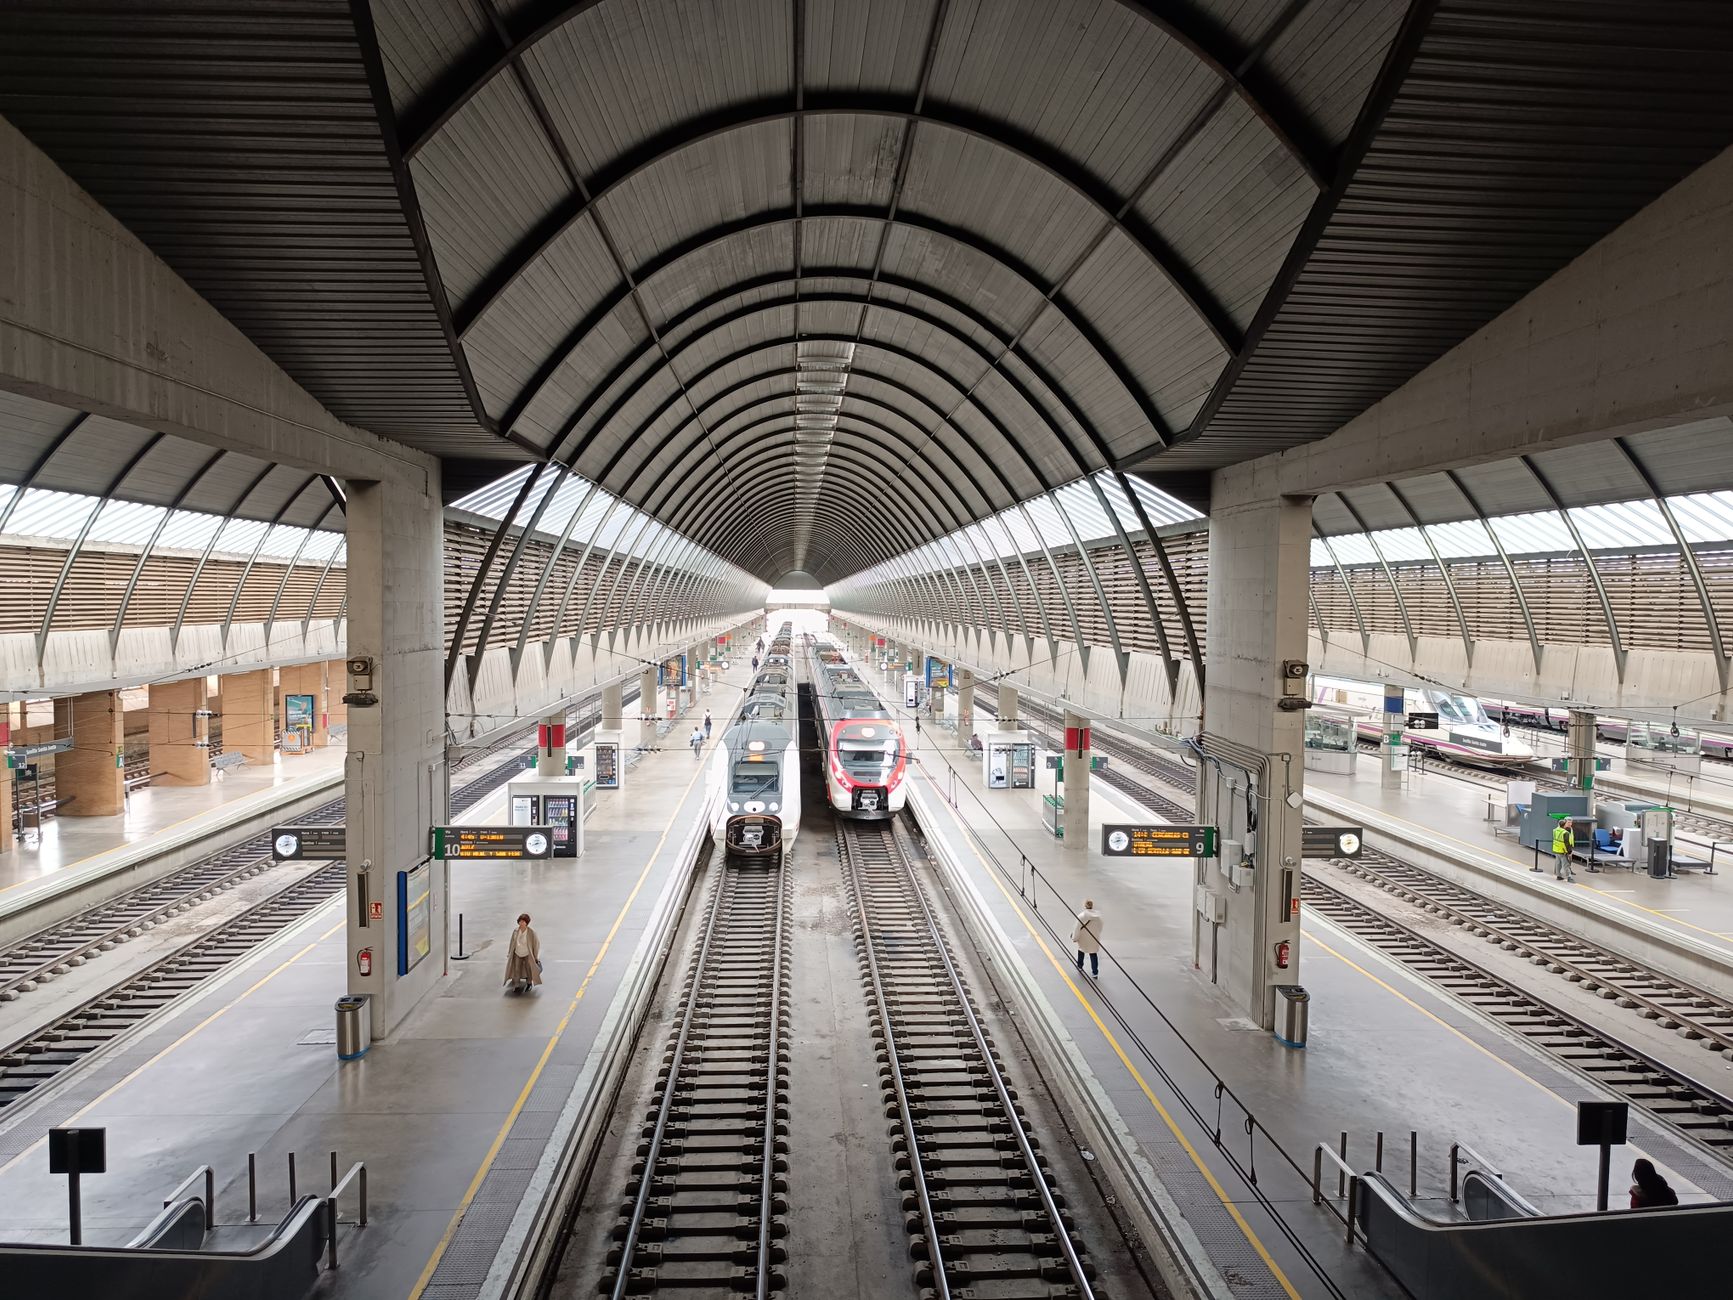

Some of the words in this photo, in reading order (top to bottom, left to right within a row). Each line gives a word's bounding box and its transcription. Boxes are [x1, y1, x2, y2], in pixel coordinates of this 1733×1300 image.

[1383, 734, 1389, 744] B
[444, 843, 460, 857] 10
[1195, 841, 1204, 855] 9
